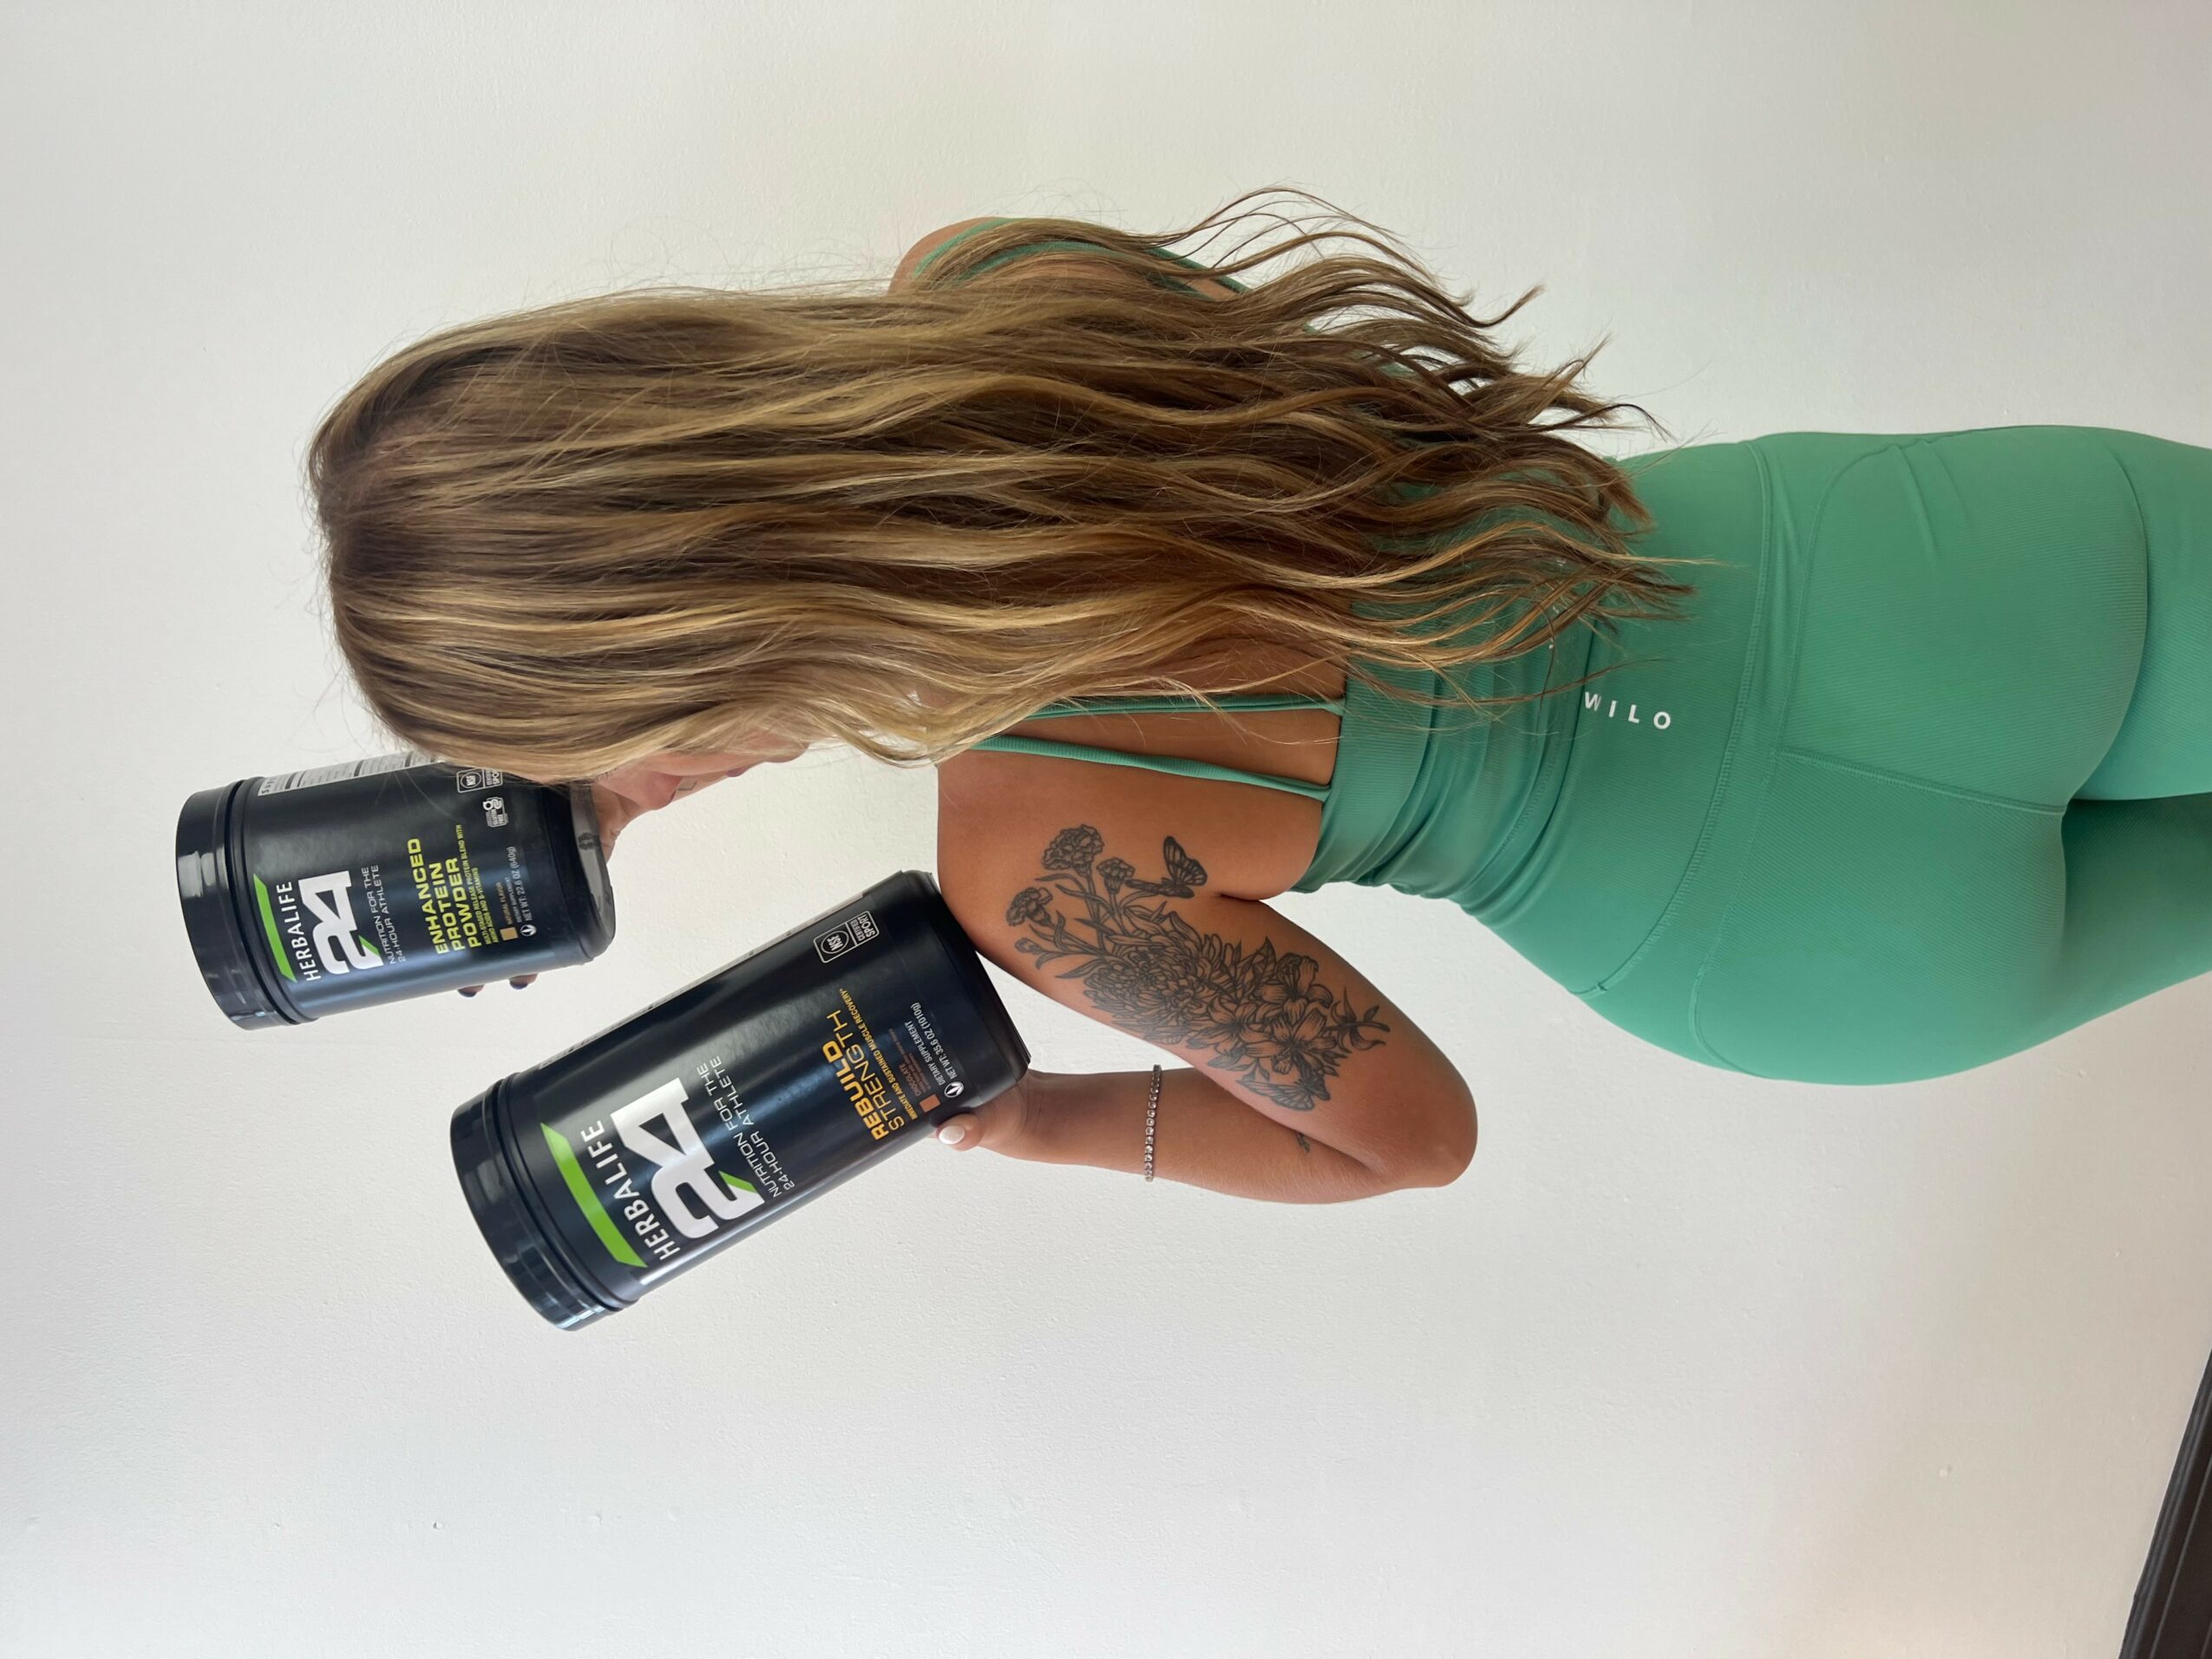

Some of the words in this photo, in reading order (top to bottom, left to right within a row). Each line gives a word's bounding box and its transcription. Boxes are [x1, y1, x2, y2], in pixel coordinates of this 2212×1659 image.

[1585, 691, 1672, 729] WILO
[457, 839, 468, 859] BLEND
[506, 846, 519, 868] (640g)
[361, 866, 371, 888] THE
[461, 859, 473, 884] PROTEIN
[511, 869, 520, 878] OZ
[370, 865, 389, 914] ATHLETE
[407, 839, 449, 954] ENHANCED
[468, 885, 480, 910] RELEASE
[495, 881, 505, 902] FLAVOR
[514, 879, 525, 895] 22.6
[366, 891, 379, 913] FOR
[429, 862, 465, 950] PROTEIN
[445, 857, 481, 947] POWDER
[479, 899, 488, 911] AND
[501, 903, 513, 924] NATURAL
[521, 909, 532, 920] NET
[276, 881, 321, 981] HERBALIFE
[298, 870, 383, 974] 24
[488, 927, 499, 942] AMINO
[849, 918, 865, 941] CERTIFIED
[857, 913, 875, 937] SPORT
[373, 915, 396, 963] NUTRITION
[383, 918, 406, 962] 24-HOUR
[827, 934, 843, 950] NSF
[909, 1001, 930, 1029] (1010g)
[858, 1022, 877, 1050] MUSCLE
[904, 1019, 933, 1062] SUPPLEMENT
[924, 1028, 935, 1040] OZ
[929, 1038, 943, 1055] 35.6
[696, 1062, 715, 1095] THE
[826, 1009, 905, 1131] STRENGTH
[872, 1049, 896, 1083] SUSTAINED
[899, 1062, 921, 1096] CHOCOLATE
[927, 1061, 946, 1085] DIETARY
[945, 1065, 957, 1079] NET
[709, 1055, 754, 1124] ATHLETE
[821, 1039, 889, 1140] REBUILD
[891, 1081, 903, 1094] AND
[713, 1096, 738, 1131] FOR
[898, 1094, 918, 1120] IMMEDIATE
[609, 1077, 765, 1239] 24
[733, 1132, 782, 1198] NUTRITION
[749, 1130, 795, 1190] 24-HOUR
[579, 1120, 680, 1260] HERBALIFE
